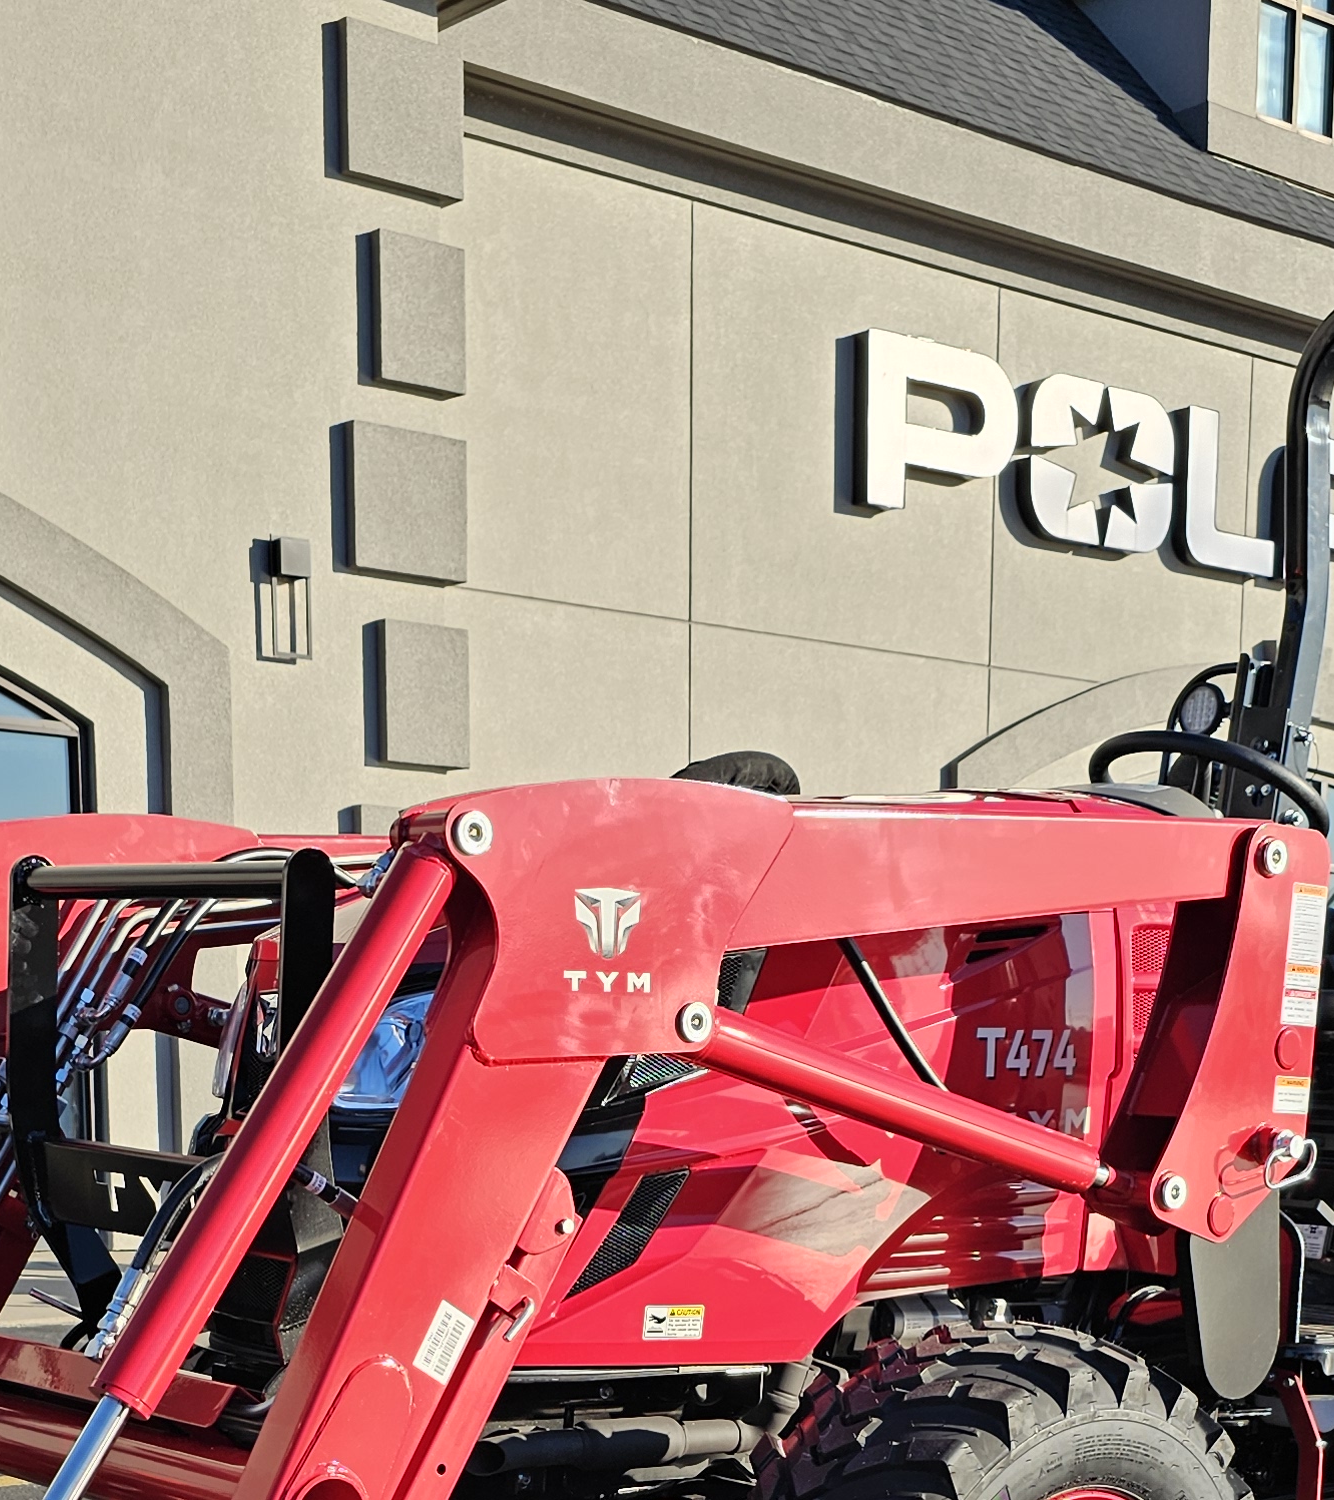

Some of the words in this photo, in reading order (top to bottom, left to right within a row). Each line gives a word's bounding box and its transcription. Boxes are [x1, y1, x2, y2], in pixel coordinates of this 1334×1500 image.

[563, 970, 651, 993] TYM
[976, 1027, 1077, 1078] T474
[93, 1169, 195, 1212] TY
[676, 1308, 701, 1317] CAUTION
